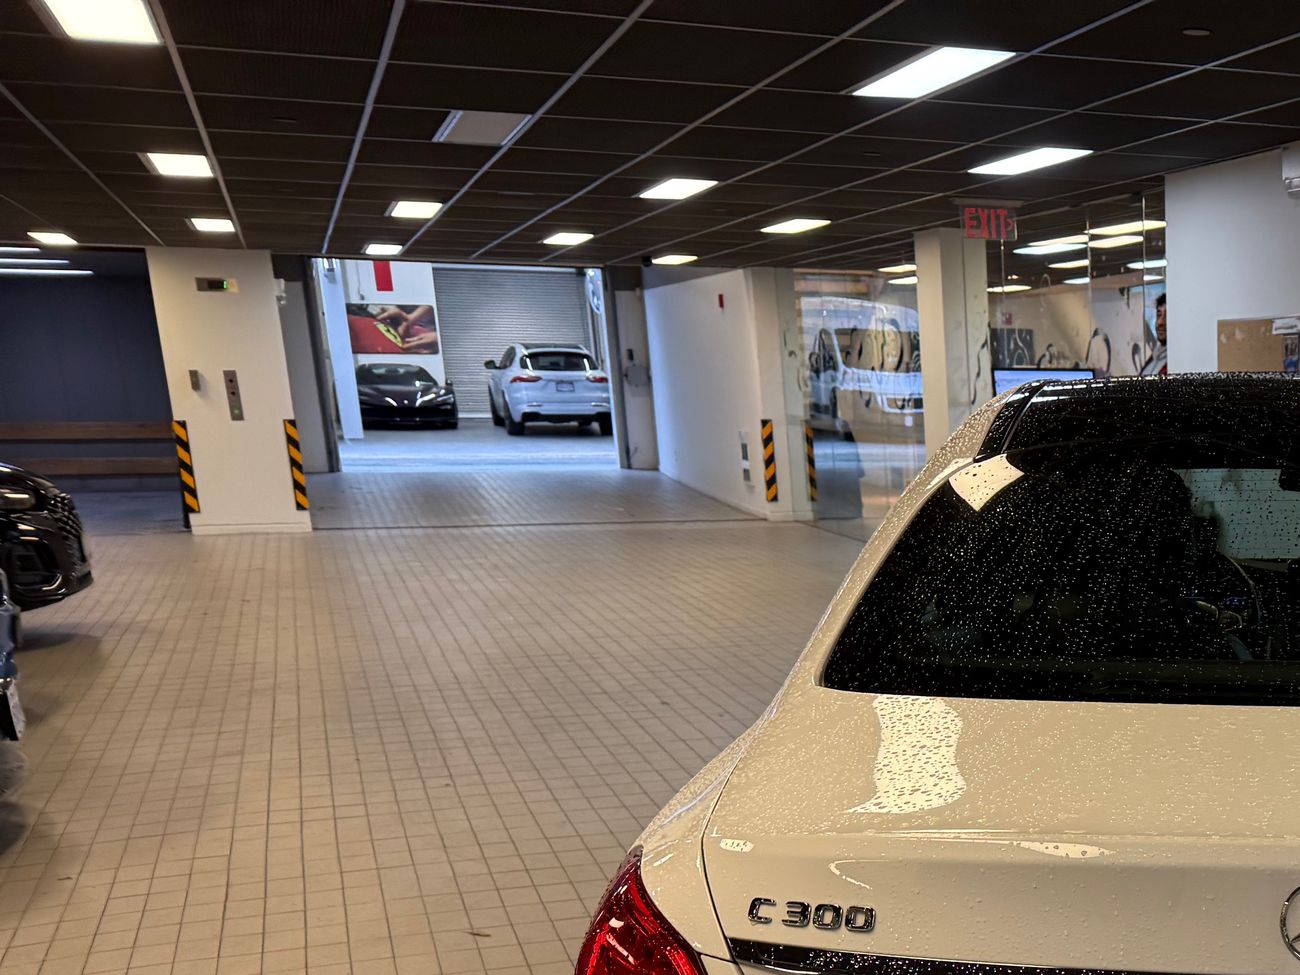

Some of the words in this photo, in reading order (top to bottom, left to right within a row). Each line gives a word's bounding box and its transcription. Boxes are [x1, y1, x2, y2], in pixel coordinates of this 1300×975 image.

[964, 207, 1008, 240] EXIT
[747, 897, 777, 924] C
[782, 901, 877, 932] 300
